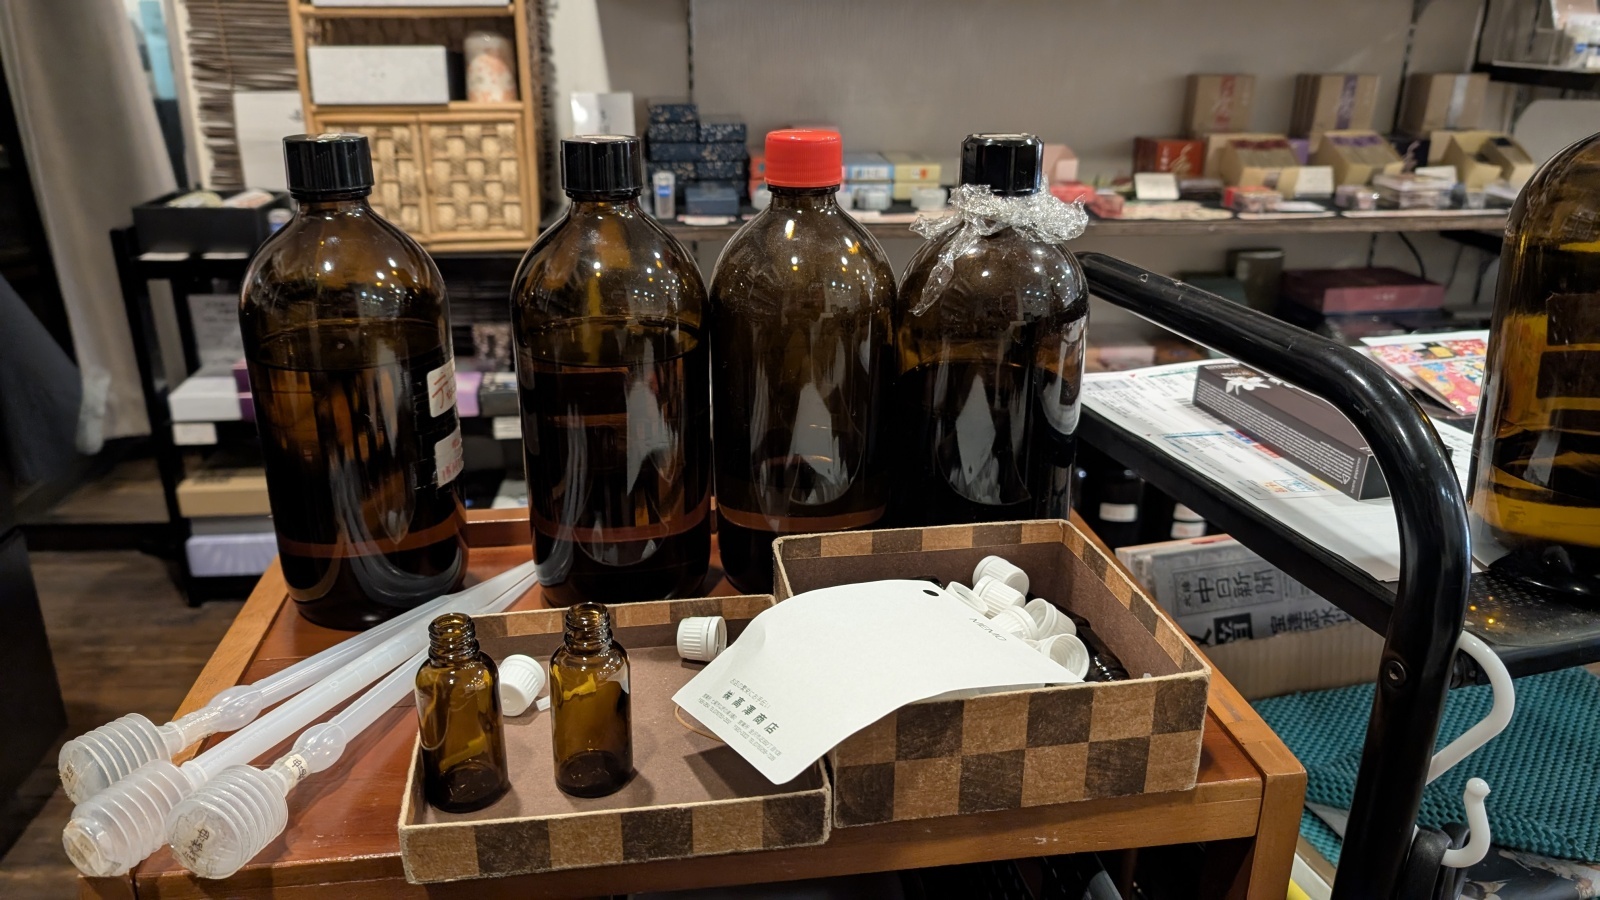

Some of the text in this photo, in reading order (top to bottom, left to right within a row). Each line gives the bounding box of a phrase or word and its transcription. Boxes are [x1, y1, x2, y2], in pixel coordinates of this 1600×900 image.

[1194, 569, 1276, 604] 中日新聞
[969, 617, 1007, 641] MEMO
